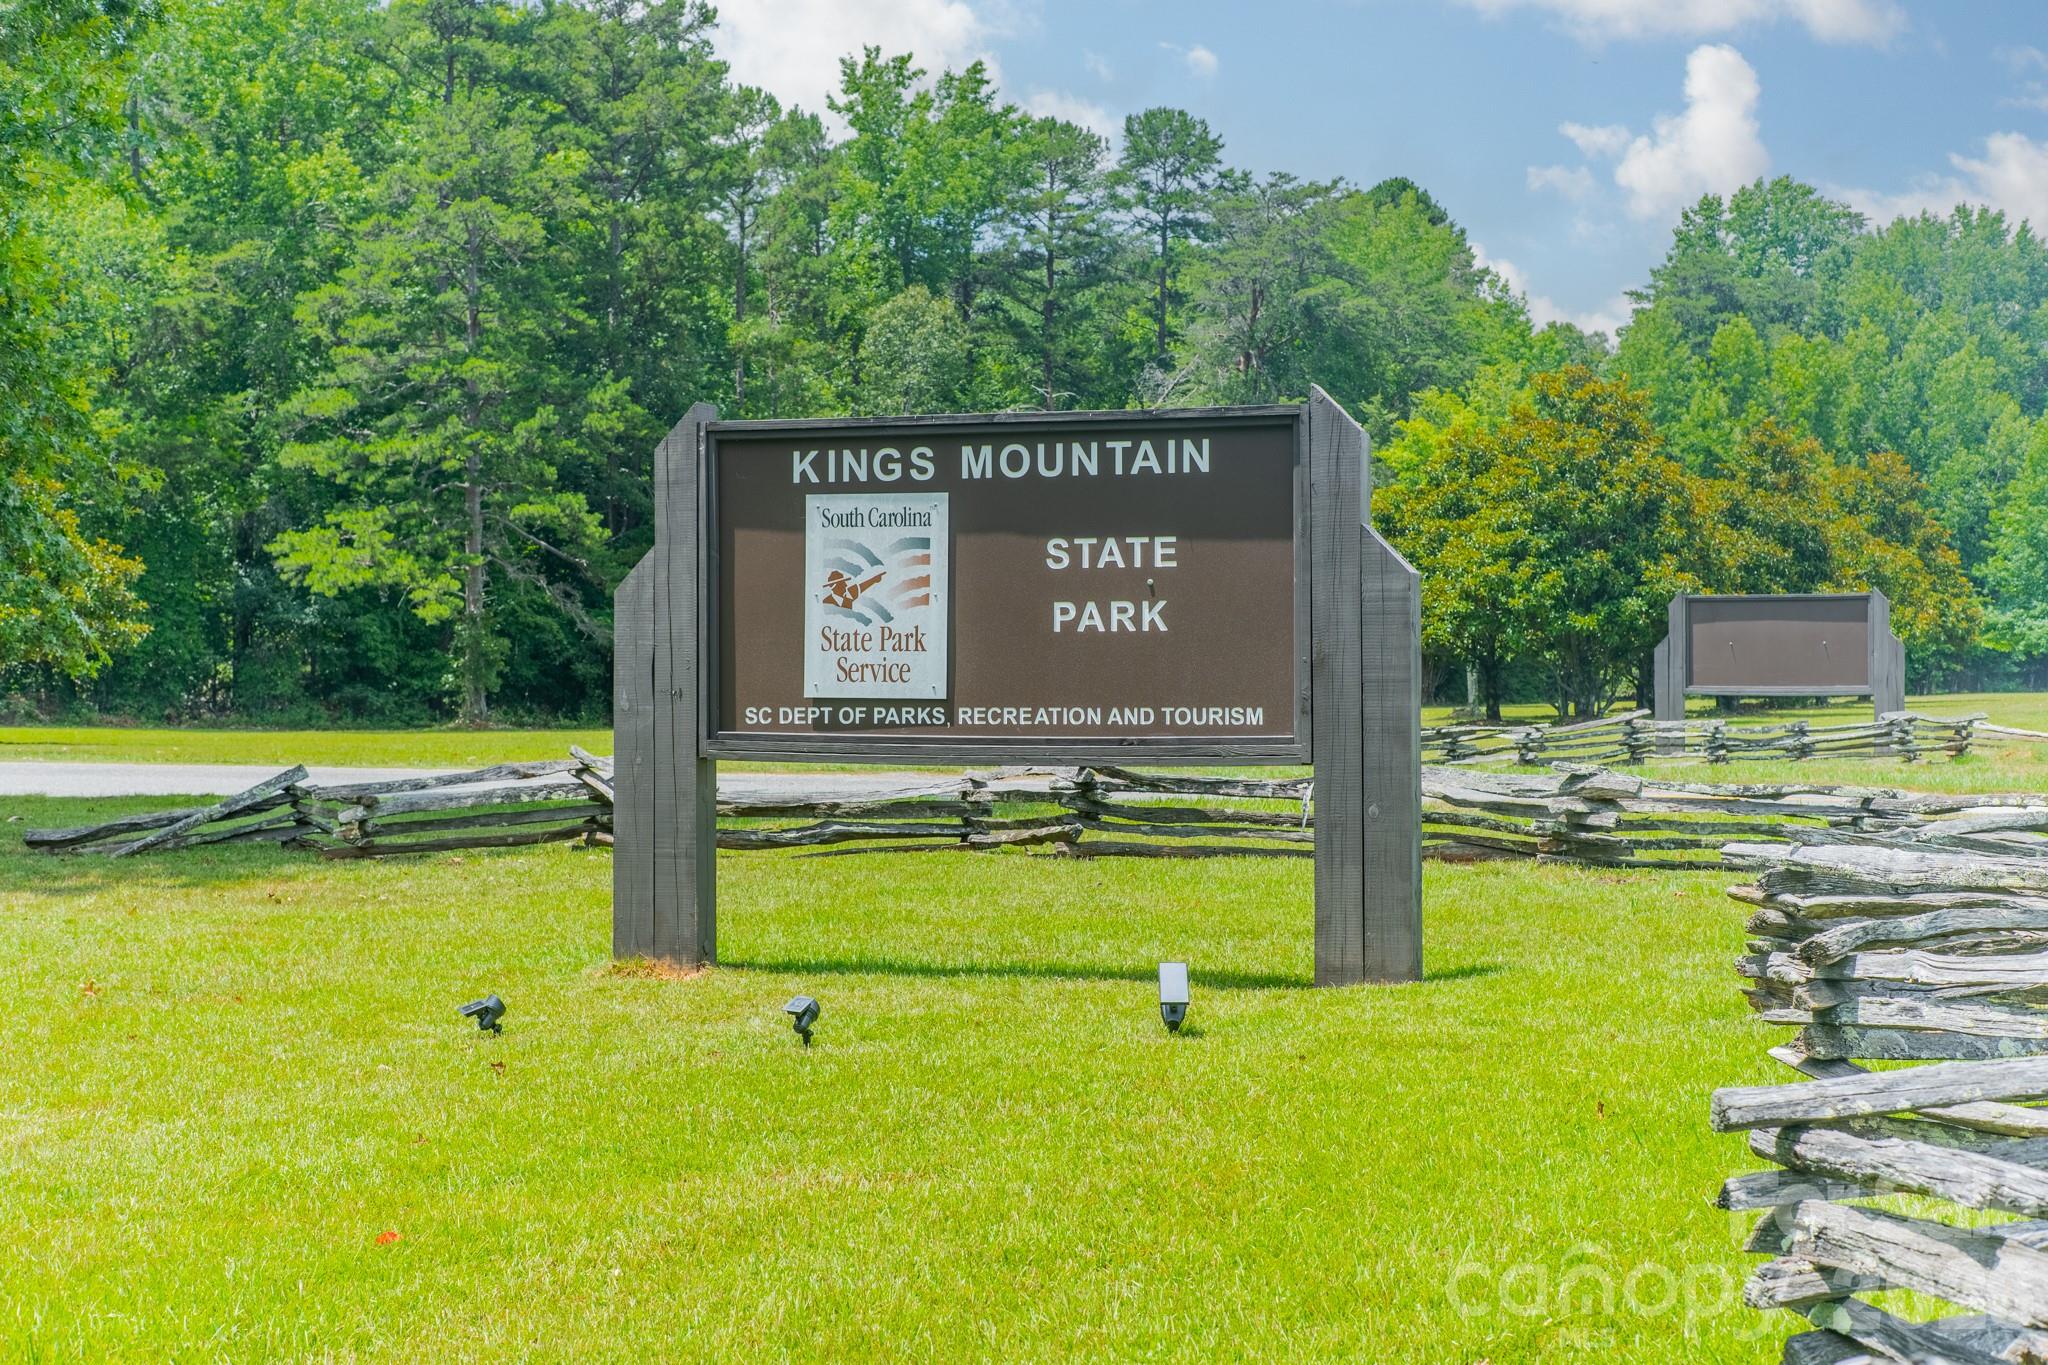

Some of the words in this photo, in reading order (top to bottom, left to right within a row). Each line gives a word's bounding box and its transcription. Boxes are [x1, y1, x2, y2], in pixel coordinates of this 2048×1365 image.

[793, 446, 935, 483] KINGS
[961, 438, 1210, 479] MOUNTAIN
[821, 508, 865, 529] South
[868, 506, 932, 528] Carolina
[1046, 536, 1178, 570] STATE
[1053, 600, 1168, 633] PARK
[821, 625, 873, 652] State
[879, 625, 927, 652] Park
[836, 656, 911, 683] Service
[745, 707, 772, 726] SC
[778, 706, 832, 725] DEPT
[838, 706, 866, 725] OF
[873, 706, 950, 728] PARKS,
[957, 707, 1101, 725] RECREATION
[1107, 707, 1155, 726] AND
[1161, 707, 1263, 726] TOURISM
